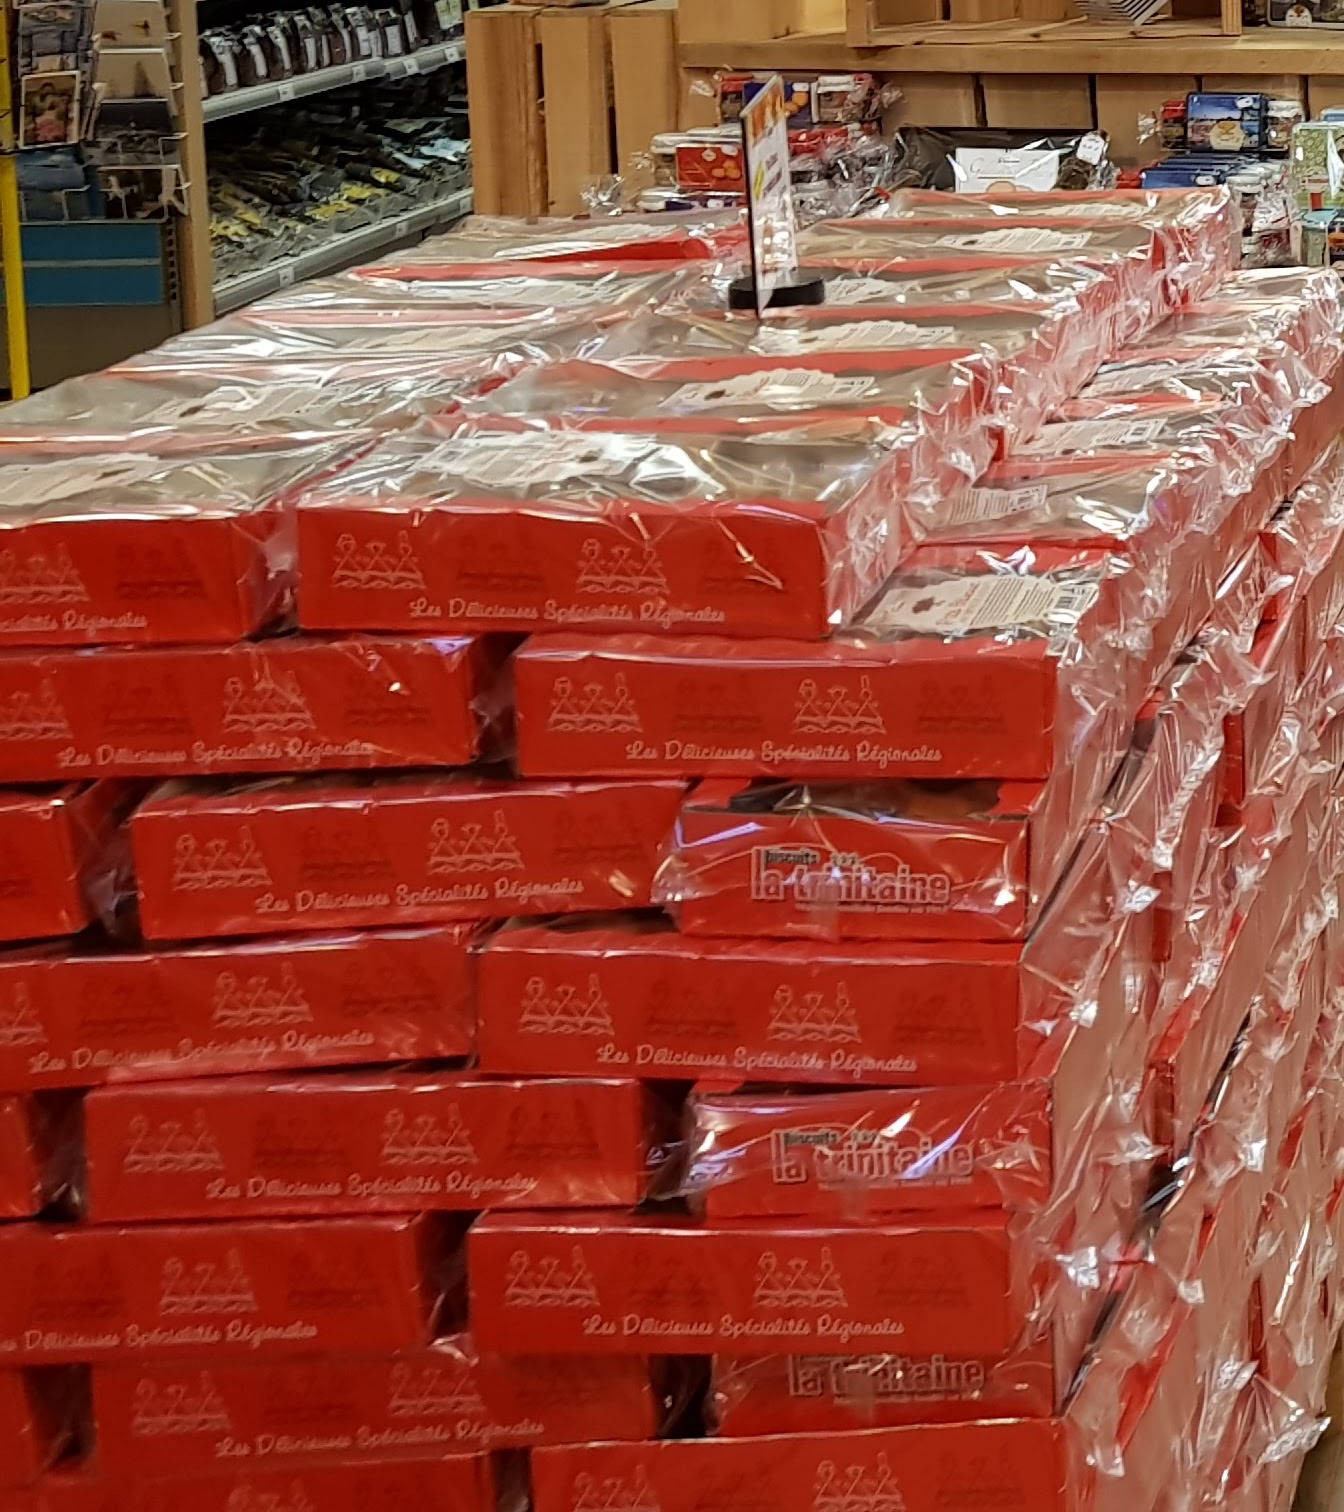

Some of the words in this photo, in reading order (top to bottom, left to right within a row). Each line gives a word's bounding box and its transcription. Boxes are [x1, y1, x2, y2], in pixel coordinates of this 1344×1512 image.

[0, 613, 57, 633] cialités
[409, 598, 442, 620] Les
[626, 741, 658, 761] Les
[665, 741, 755, 761] Délicieuses
[761, 742, 850, 765] Spécialités
[857, 741, 943, 769] Régionales
[752, 846, 786, 900] la
[596, 1044, 630, 1065] Les
[635, 1044, 727, 1067] Délicieuses
[733, 1045, 825, 1071] Spécialités
[830, 1050, 917, 1078] Régionales
[583, 1314, 617, 1337] Les
[622, 1314, 714, 1337] Délicieuses
[719, 1313, 812, 1340] Spécialités
[817, 1313, 904, 1344] Régionales
[830, 1354, 985, 1395] tnitaine
